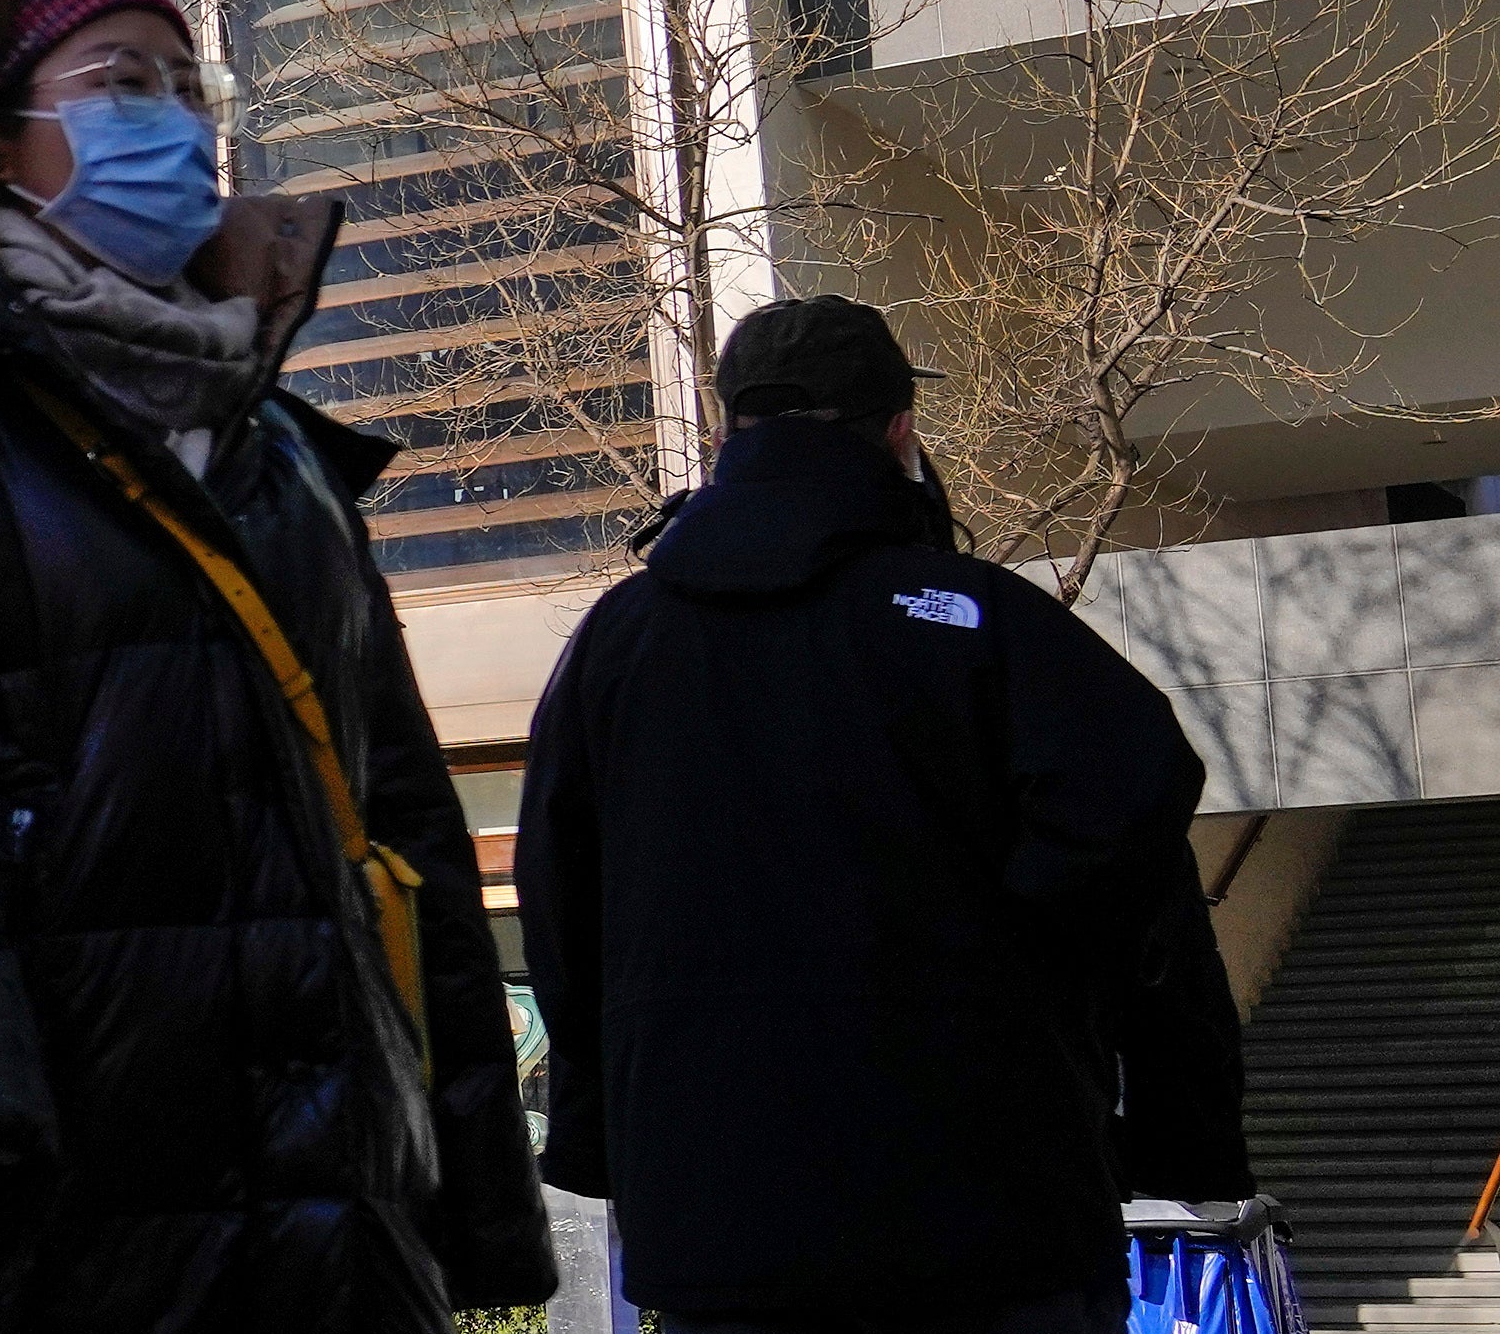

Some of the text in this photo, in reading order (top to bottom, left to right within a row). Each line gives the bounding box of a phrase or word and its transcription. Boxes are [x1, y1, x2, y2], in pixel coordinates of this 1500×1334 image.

[892, 593, 950, 612] NORTH
[920, 588, 954, 603] THE
[906, 607, 950, 624] FACE
